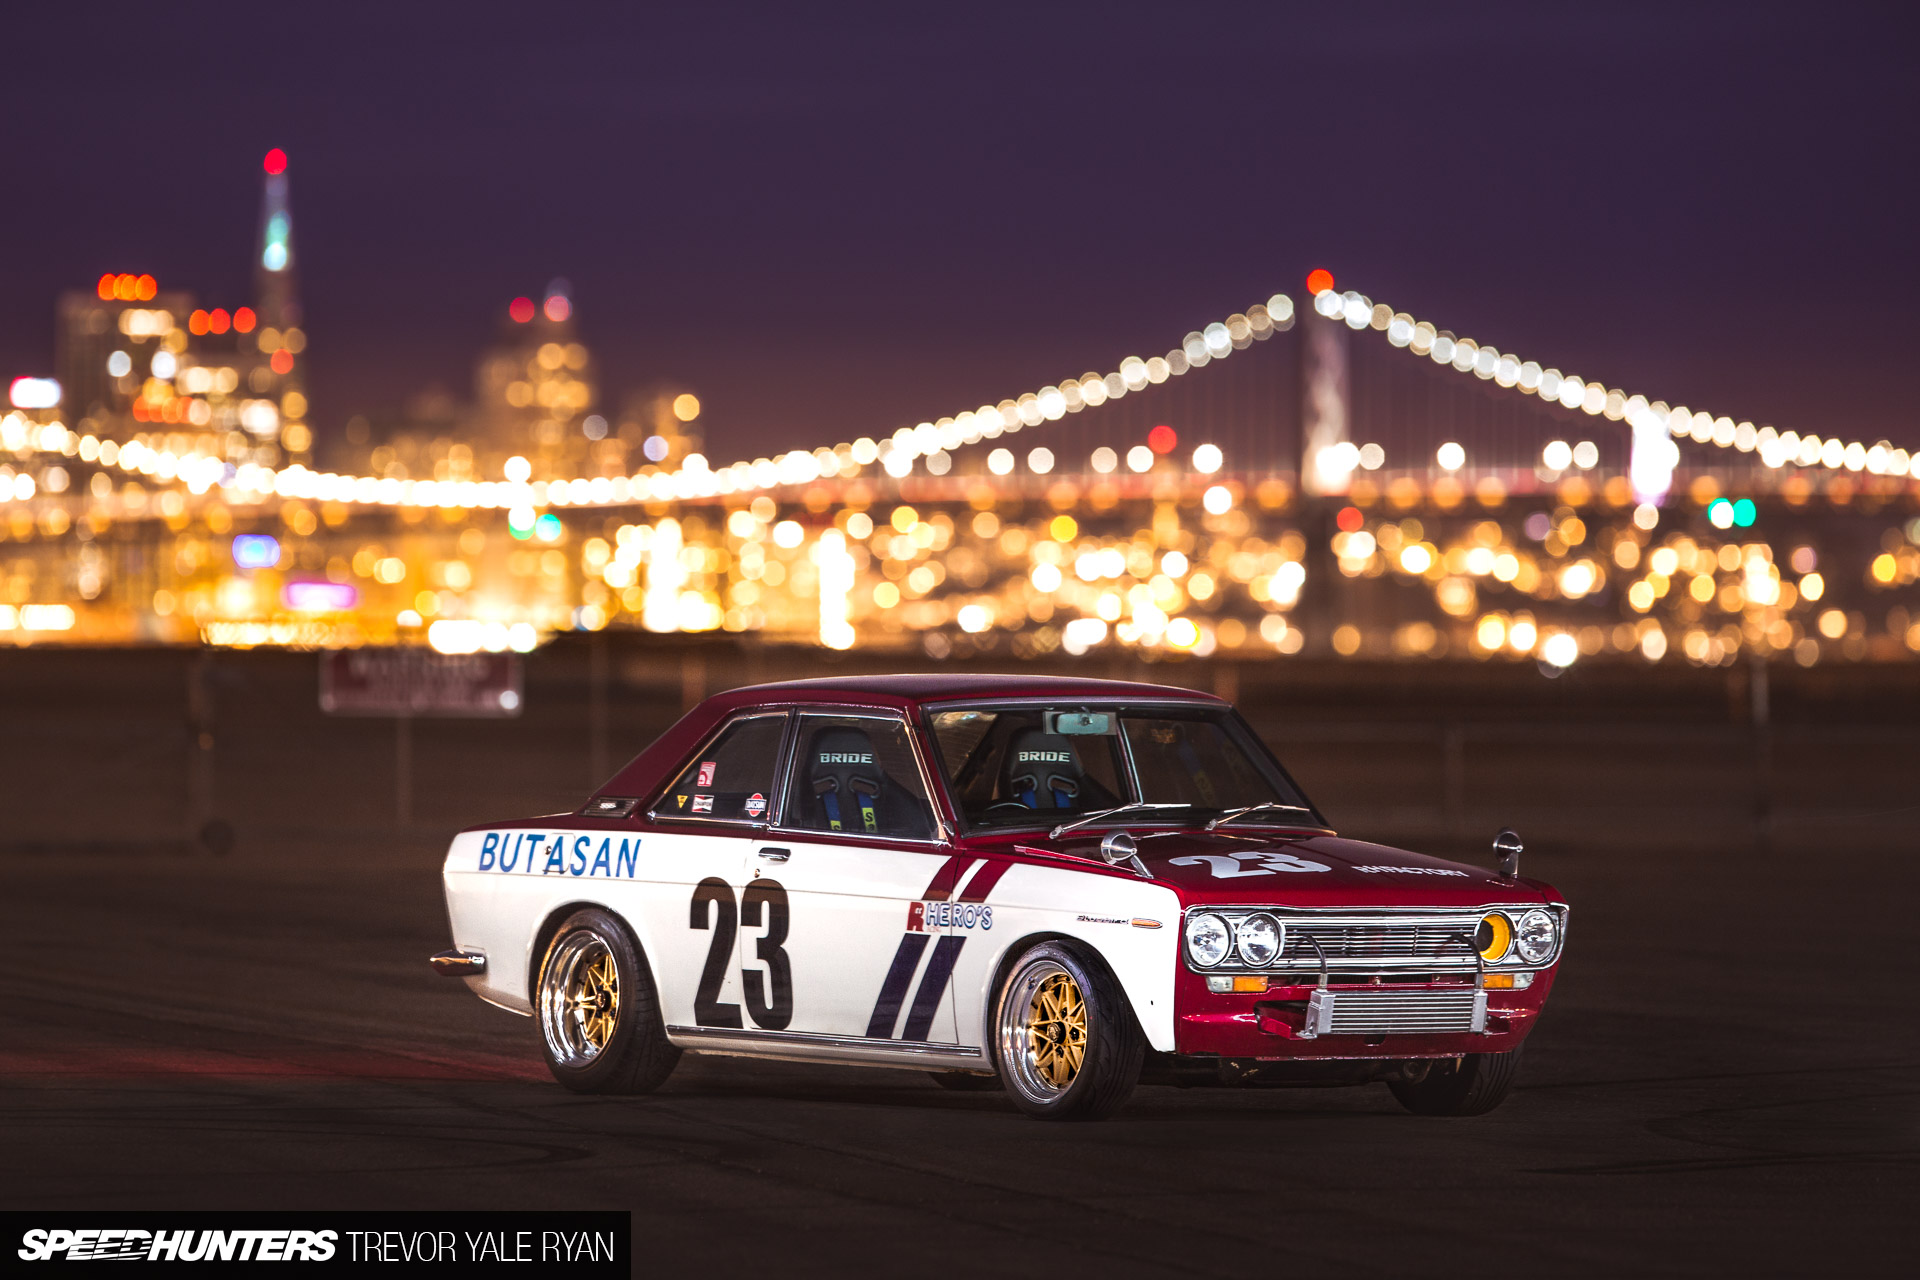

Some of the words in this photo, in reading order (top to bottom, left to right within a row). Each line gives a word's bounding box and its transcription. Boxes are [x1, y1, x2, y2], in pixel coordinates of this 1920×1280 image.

[820, 752, 873, 764] BRIDE
[1018, 751, 1071, 763] BRIDE
[479, 833, 642, 878] BUTASAN
[1168, 851, 1332, 879] 23
[689, 876, 794, 1031] 23
